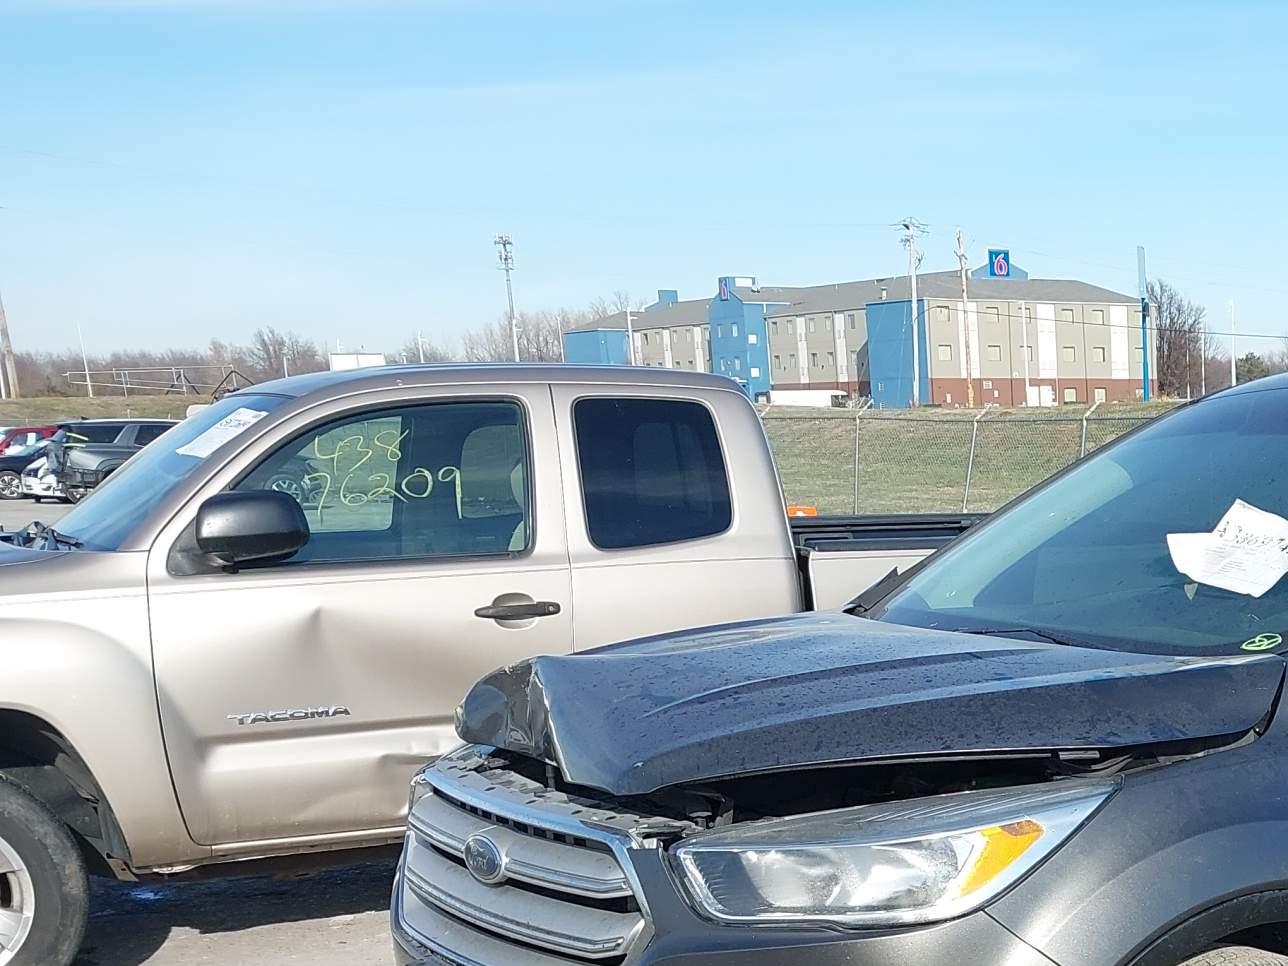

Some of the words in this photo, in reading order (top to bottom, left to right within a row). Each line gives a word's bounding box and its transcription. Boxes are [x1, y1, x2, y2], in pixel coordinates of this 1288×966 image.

[993, 253, 1008, 276] 6
[314, 429, 410, 475] 438
[304, 466, 463, 520] 76209
[226, 705, 352, 726] TACOMA
